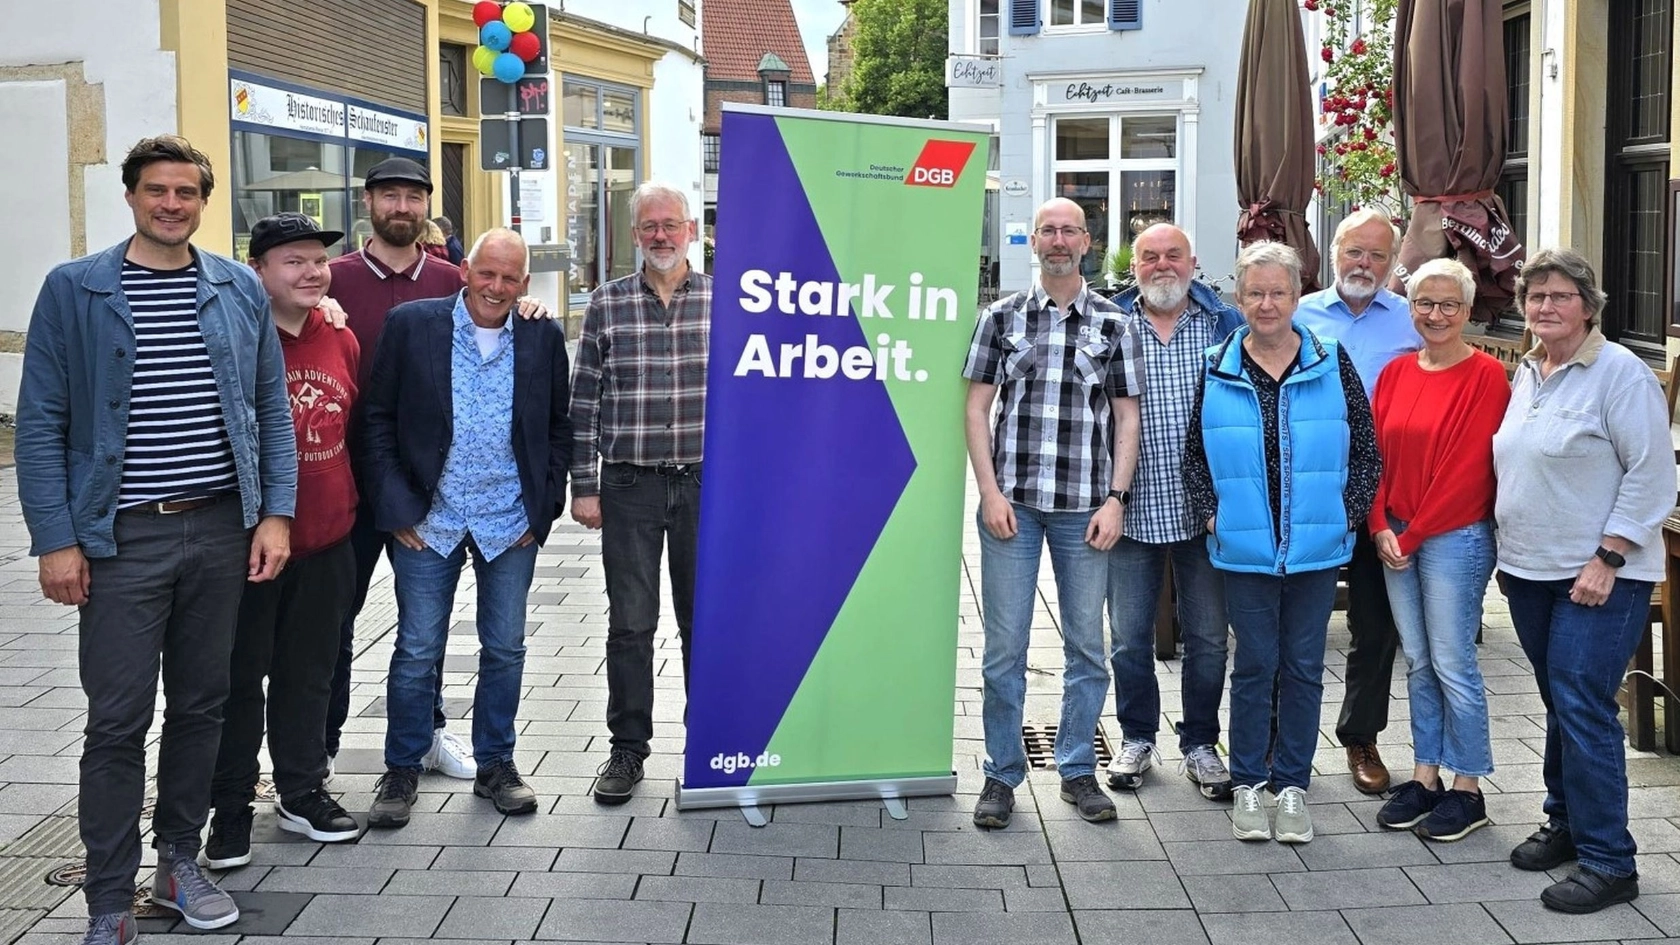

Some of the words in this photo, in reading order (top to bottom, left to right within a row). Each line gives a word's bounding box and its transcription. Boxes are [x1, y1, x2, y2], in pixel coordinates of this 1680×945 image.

[1065, 82, 1114, 103] Echtzeit
[286, 93, 344, 127] Historisches
[349, 107, 398, 137] Schaufenster
[835, 170, 904, 182] Gewerkschaftsbund
[869, 164, 905, 172] Deutscher
[914, 167, 954, 185] DGB
[738, 269, 896, 319] Stark
[908, 271, 958, 321] in
[733, 332, 929, 382] Arbeit.
[304, 369, 348, 399] ADVENTURE
[304, 449, 334, 461] OUTDOOR
[709, 751, 781, 774] dgb.de
